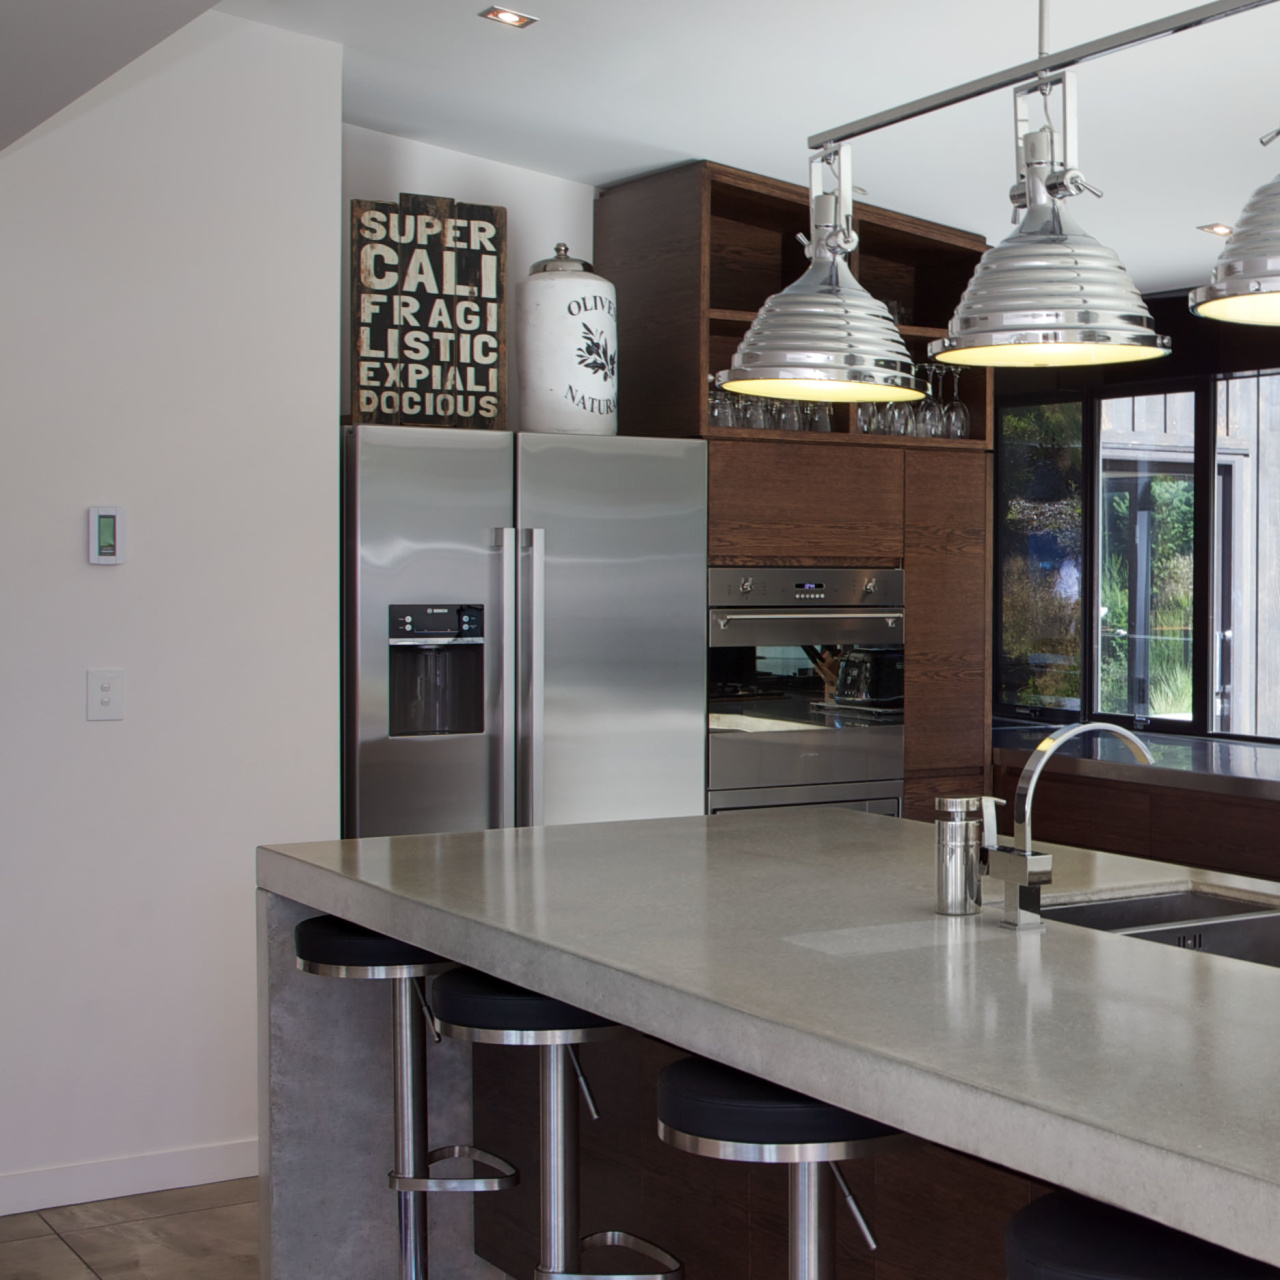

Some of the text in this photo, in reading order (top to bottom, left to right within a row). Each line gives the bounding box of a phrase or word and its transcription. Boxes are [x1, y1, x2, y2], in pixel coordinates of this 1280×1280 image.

[359, 210, 497, 252] SUPER
[360, 243, 498, 299] CALI
[360, 293, 498, 333] FRAGI
[359, 326, 499, 365] LISTIC
[359, 361, 498, 393] EXPIALI
[359, 389, 499, 418] DOCIOUS
